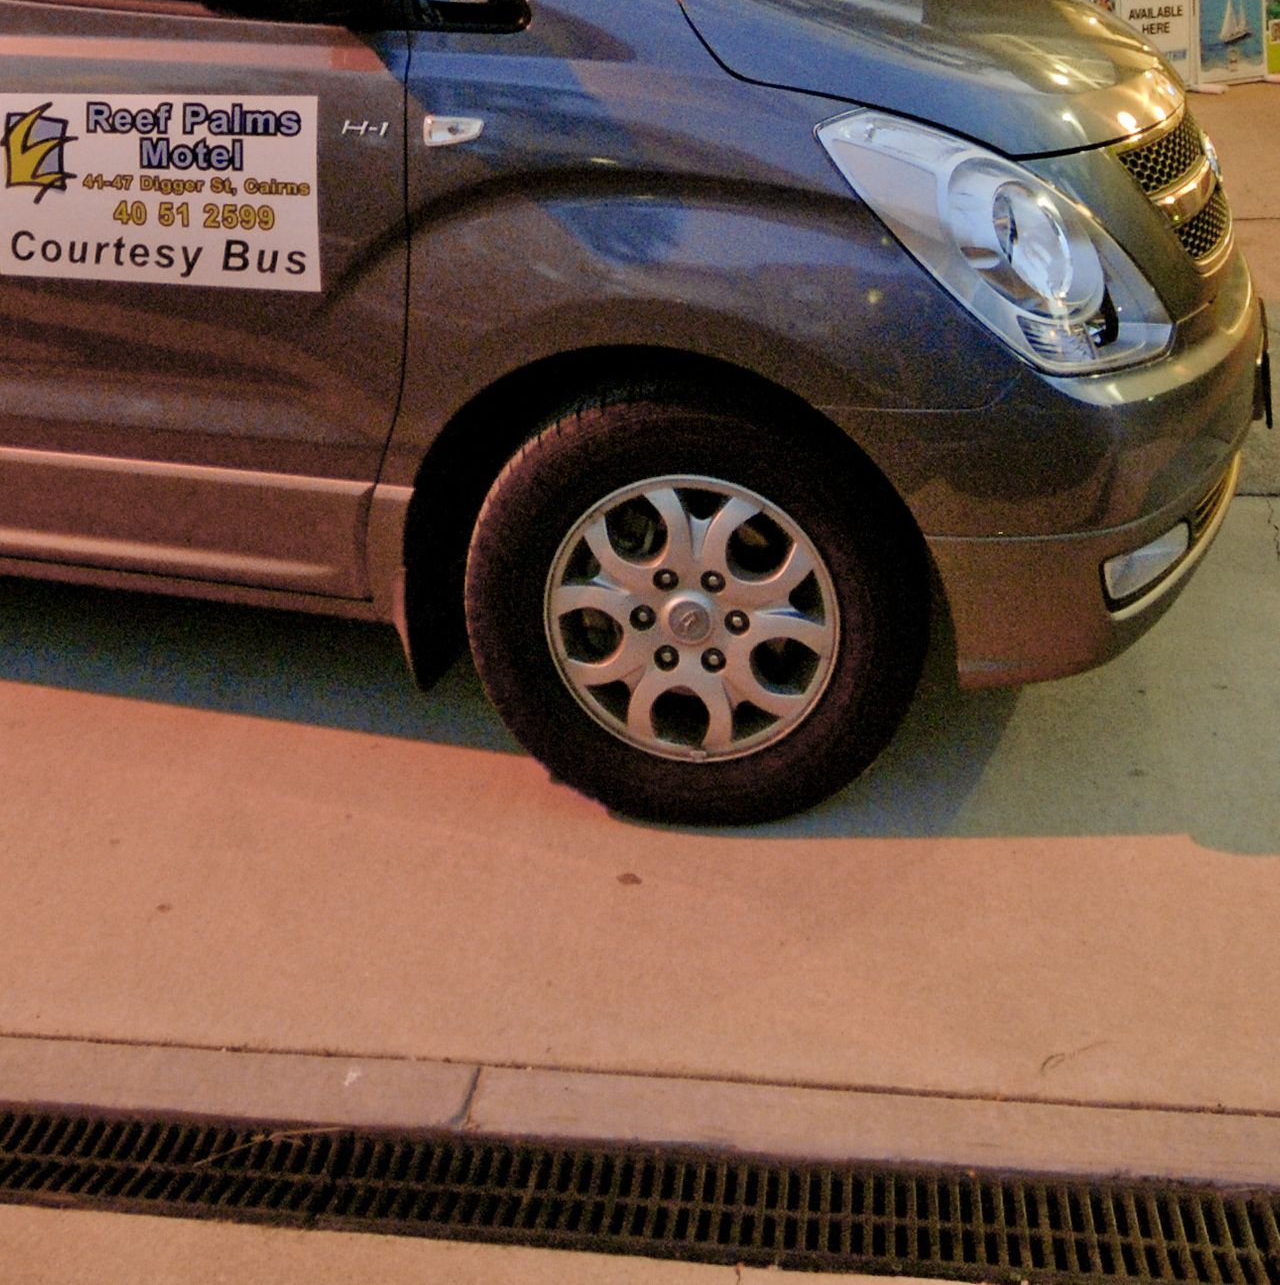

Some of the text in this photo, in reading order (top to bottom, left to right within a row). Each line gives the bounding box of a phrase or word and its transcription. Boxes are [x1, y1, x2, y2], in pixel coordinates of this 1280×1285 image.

[1128, 5, 1183, 21] AVAILABLE
[1141, 21, 1171, 35] HERE
[86, 101, 302, 137] Reef Palms
[341, 119, 389, 137] H-1
[139, 136, 244, 171] Motel
[82, 173, 311, 196] 41-47 Digger St, Cairns
[113, 200, 276, 230] 40 51 2599
[10, 230, 308, 278] Courtesy Bus
